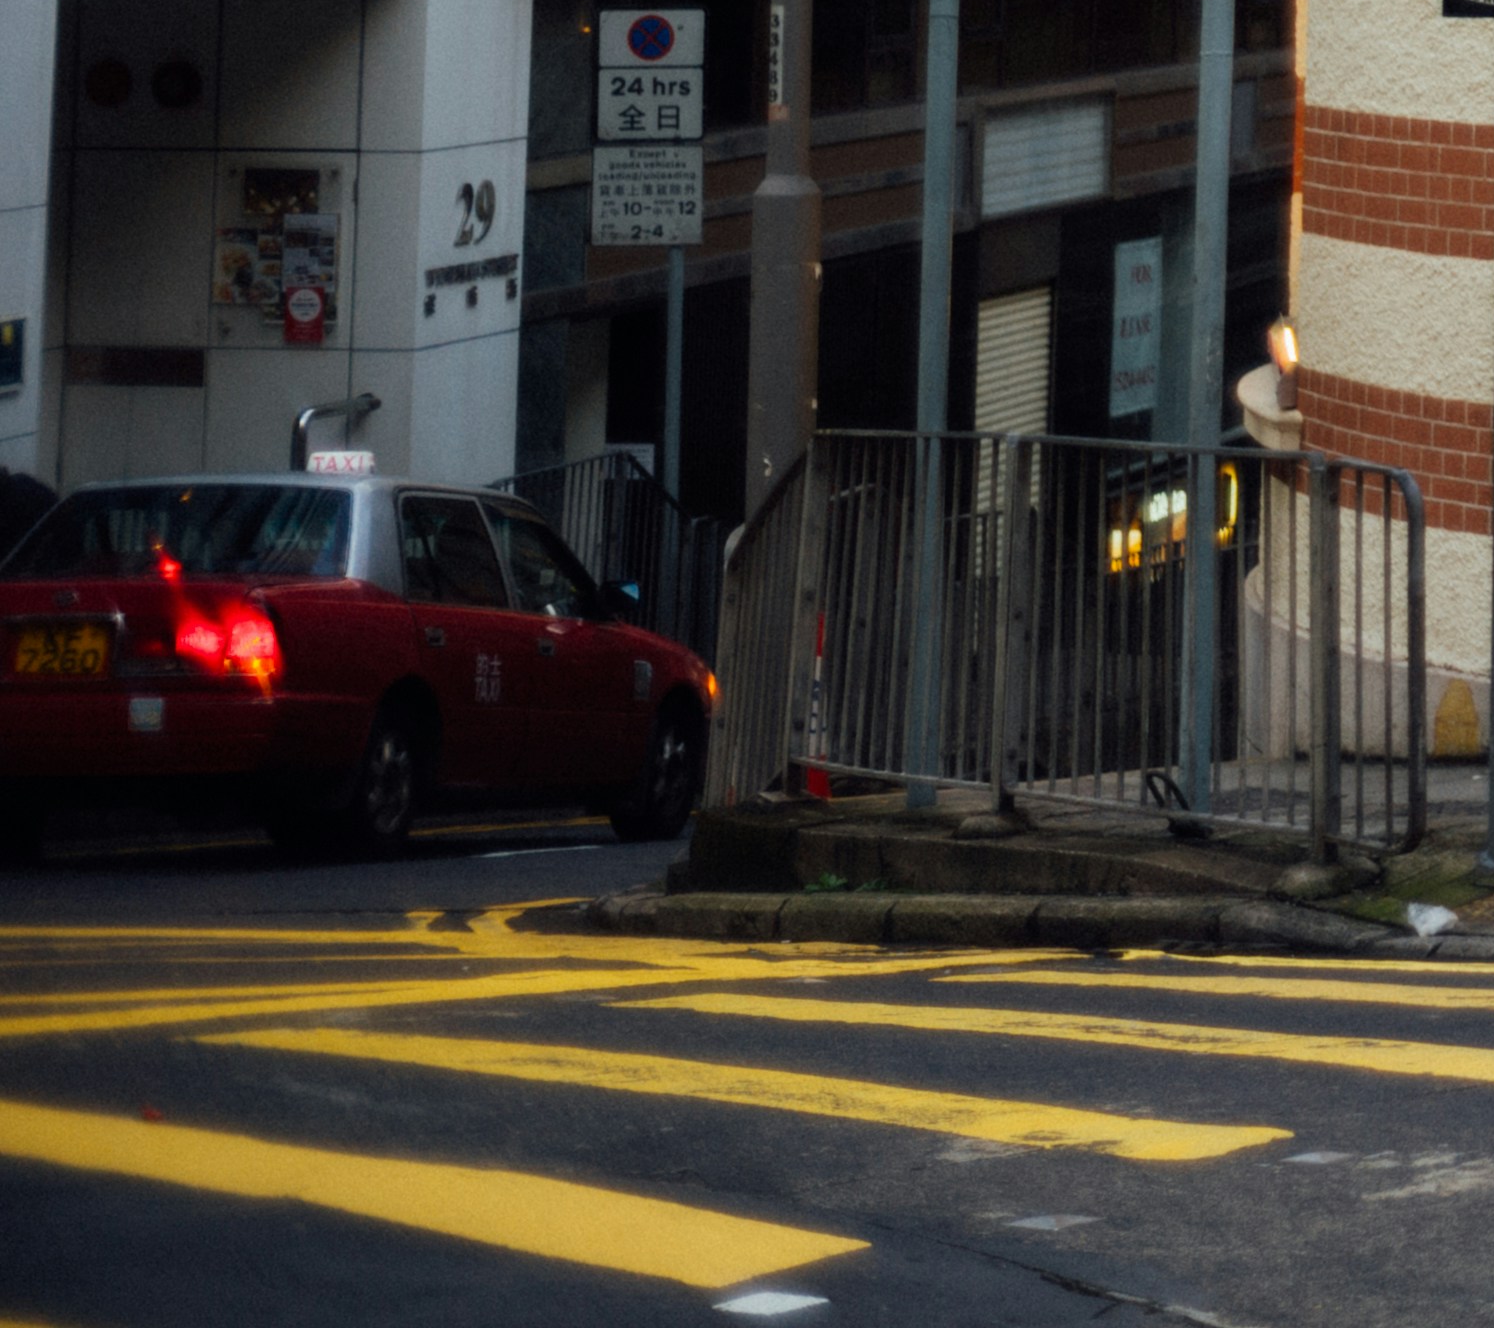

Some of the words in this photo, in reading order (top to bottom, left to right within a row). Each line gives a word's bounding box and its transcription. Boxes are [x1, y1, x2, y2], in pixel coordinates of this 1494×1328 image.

[610, 76, 645, 97] 24
[652, 76, 691, 96] hrs
[618, 103, 681, 132] 全日
[454, 179, 496, 248] 29
[678, 200, 696, 215] 12
[631, 224, 663, 239] 2-4
[312, 455, 367, 473] TAXI
